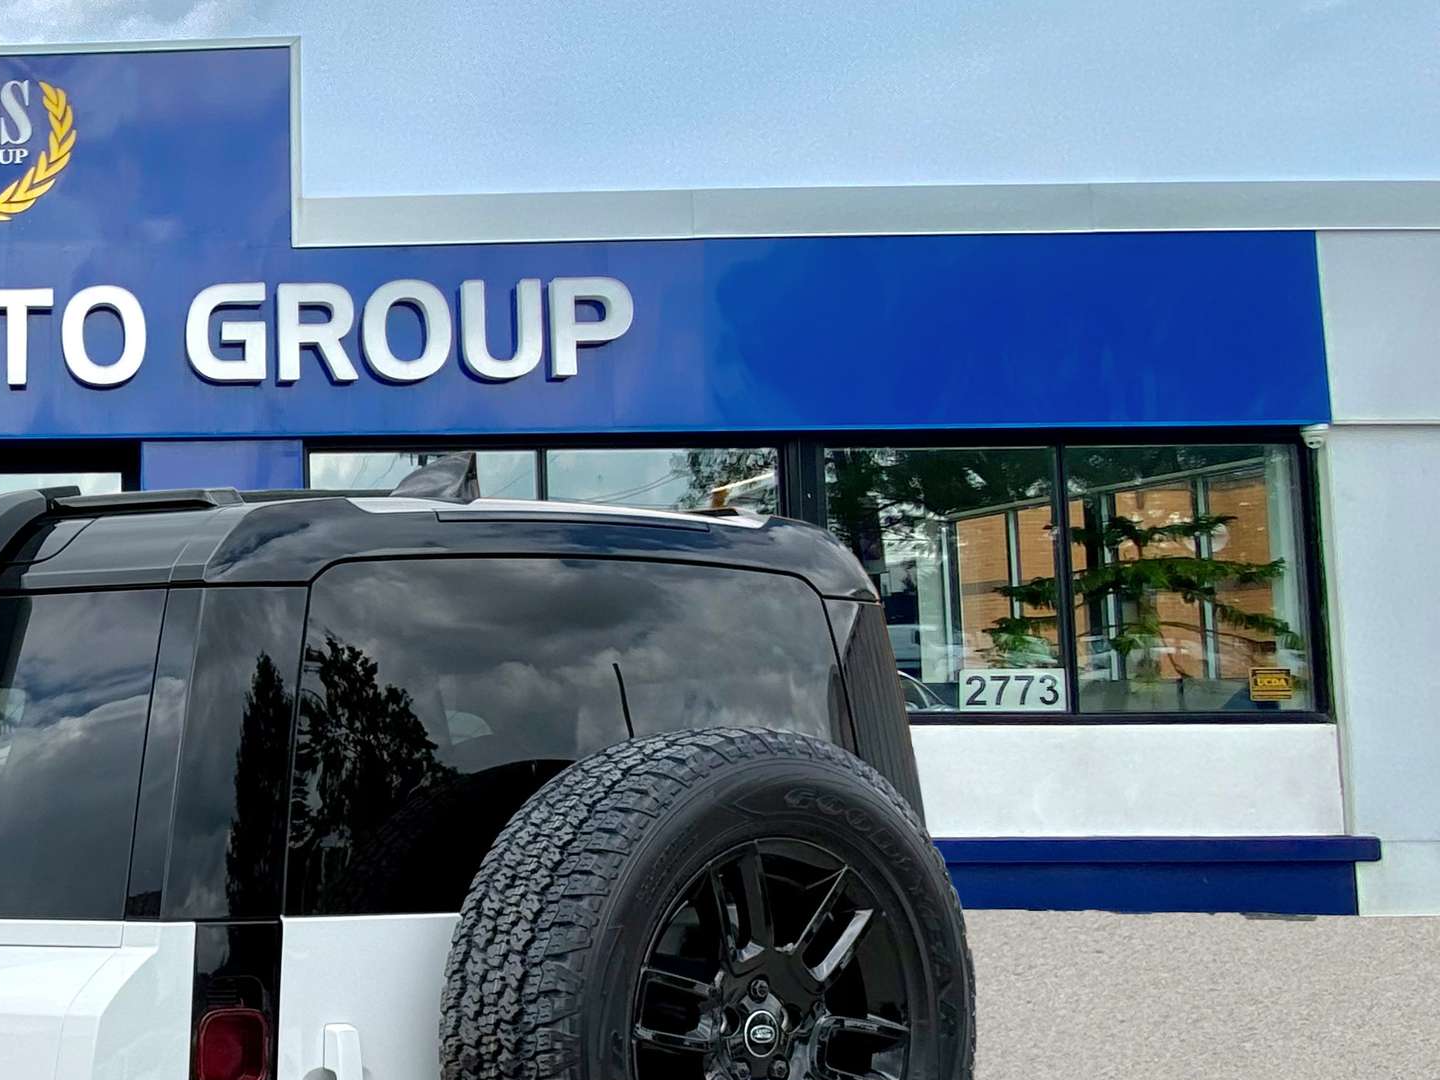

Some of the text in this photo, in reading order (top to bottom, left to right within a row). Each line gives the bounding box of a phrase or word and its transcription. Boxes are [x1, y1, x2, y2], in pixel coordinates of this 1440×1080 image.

[185, 279, 634, 386] GROUP
[965, 674, 1060, 706] 2773
[1257, 677, 1288, 687] UCDA
